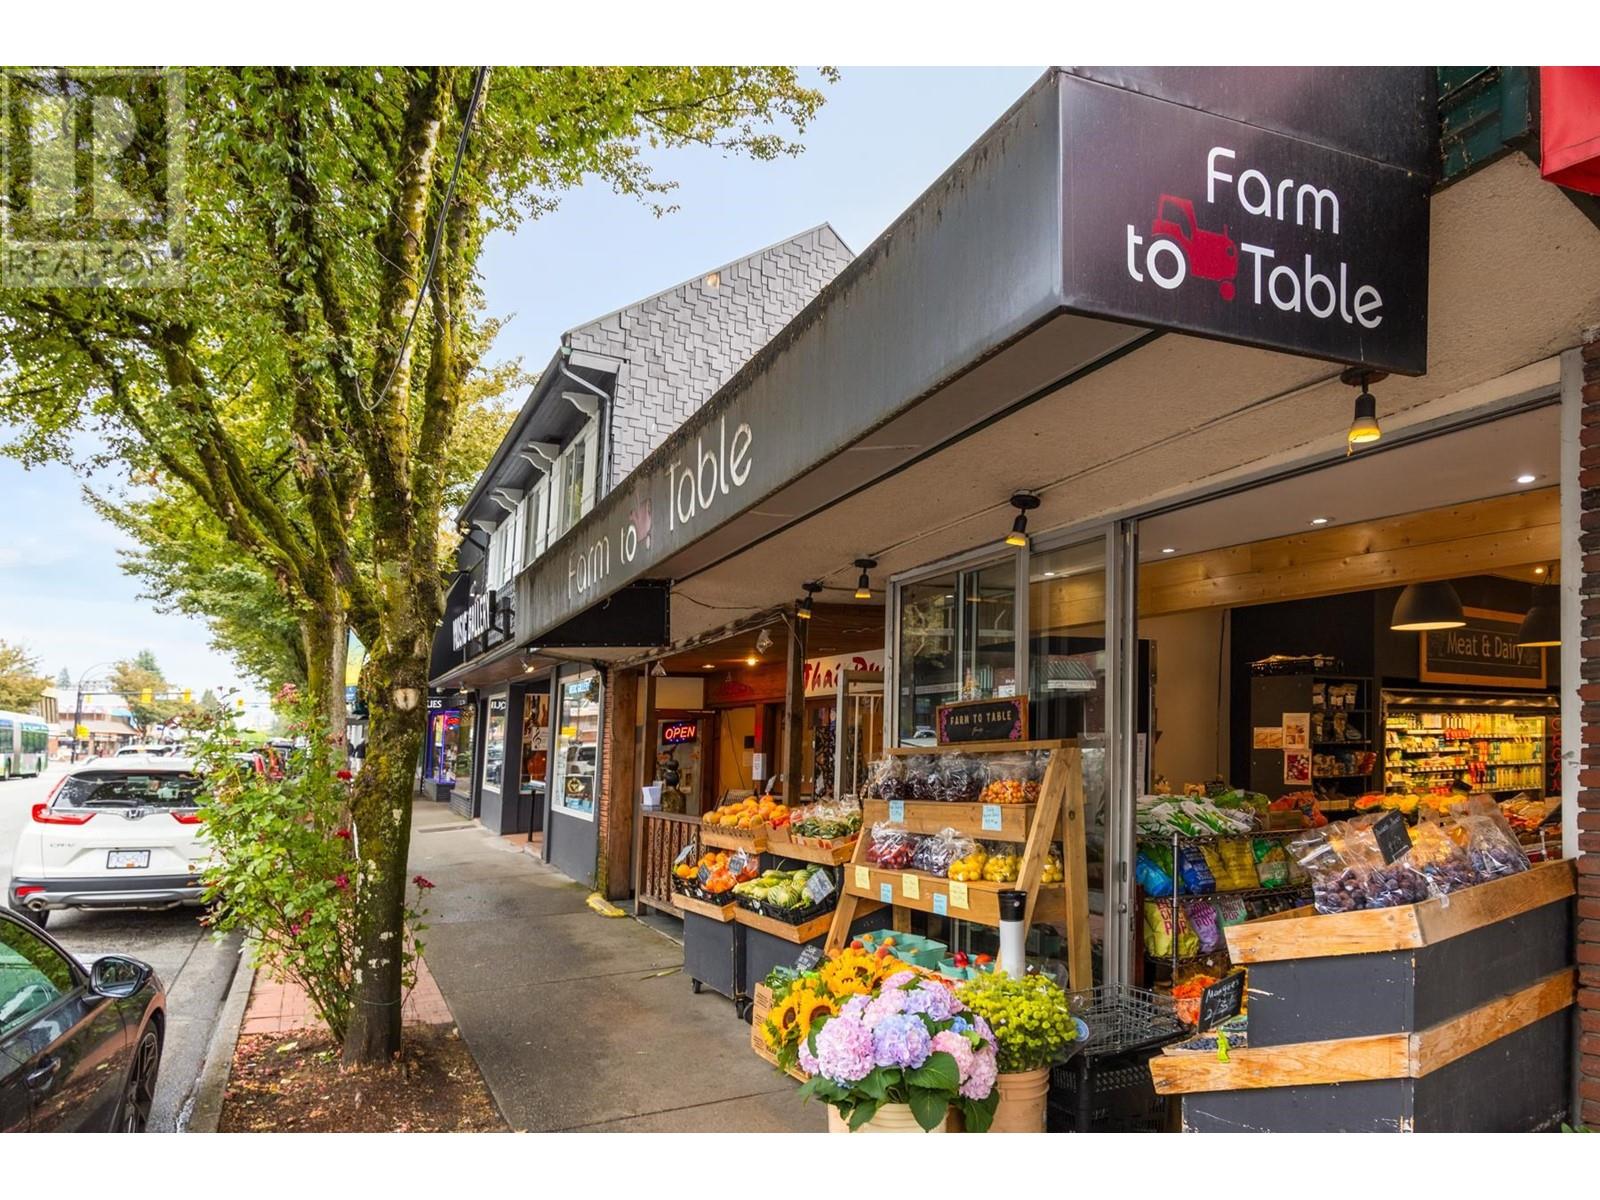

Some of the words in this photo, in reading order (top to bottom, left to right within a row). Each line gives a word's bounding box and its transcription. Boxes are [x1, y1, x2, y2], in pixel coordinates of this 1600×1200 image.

[1207, 146, 1340, 234] Farm
[1127, 223, 1187, 290] to
[1241, 243, 1384, 329] Table
[568, 536, 610, 599] Farm
[666, 414, 753, 532] Table
[1447, 631, 1478, 656] Meat
[1481, 634, 1490, 657] &
[1494, 636, 1524, 664] Dairy
[803, 661, 841, 691] Thai
[664, 726, 696, 740] OPEN
[950, 714, 970, 725] FARM
[973, 713, 983, 723] TO
[986, 710, 1012, 722] TABLE
